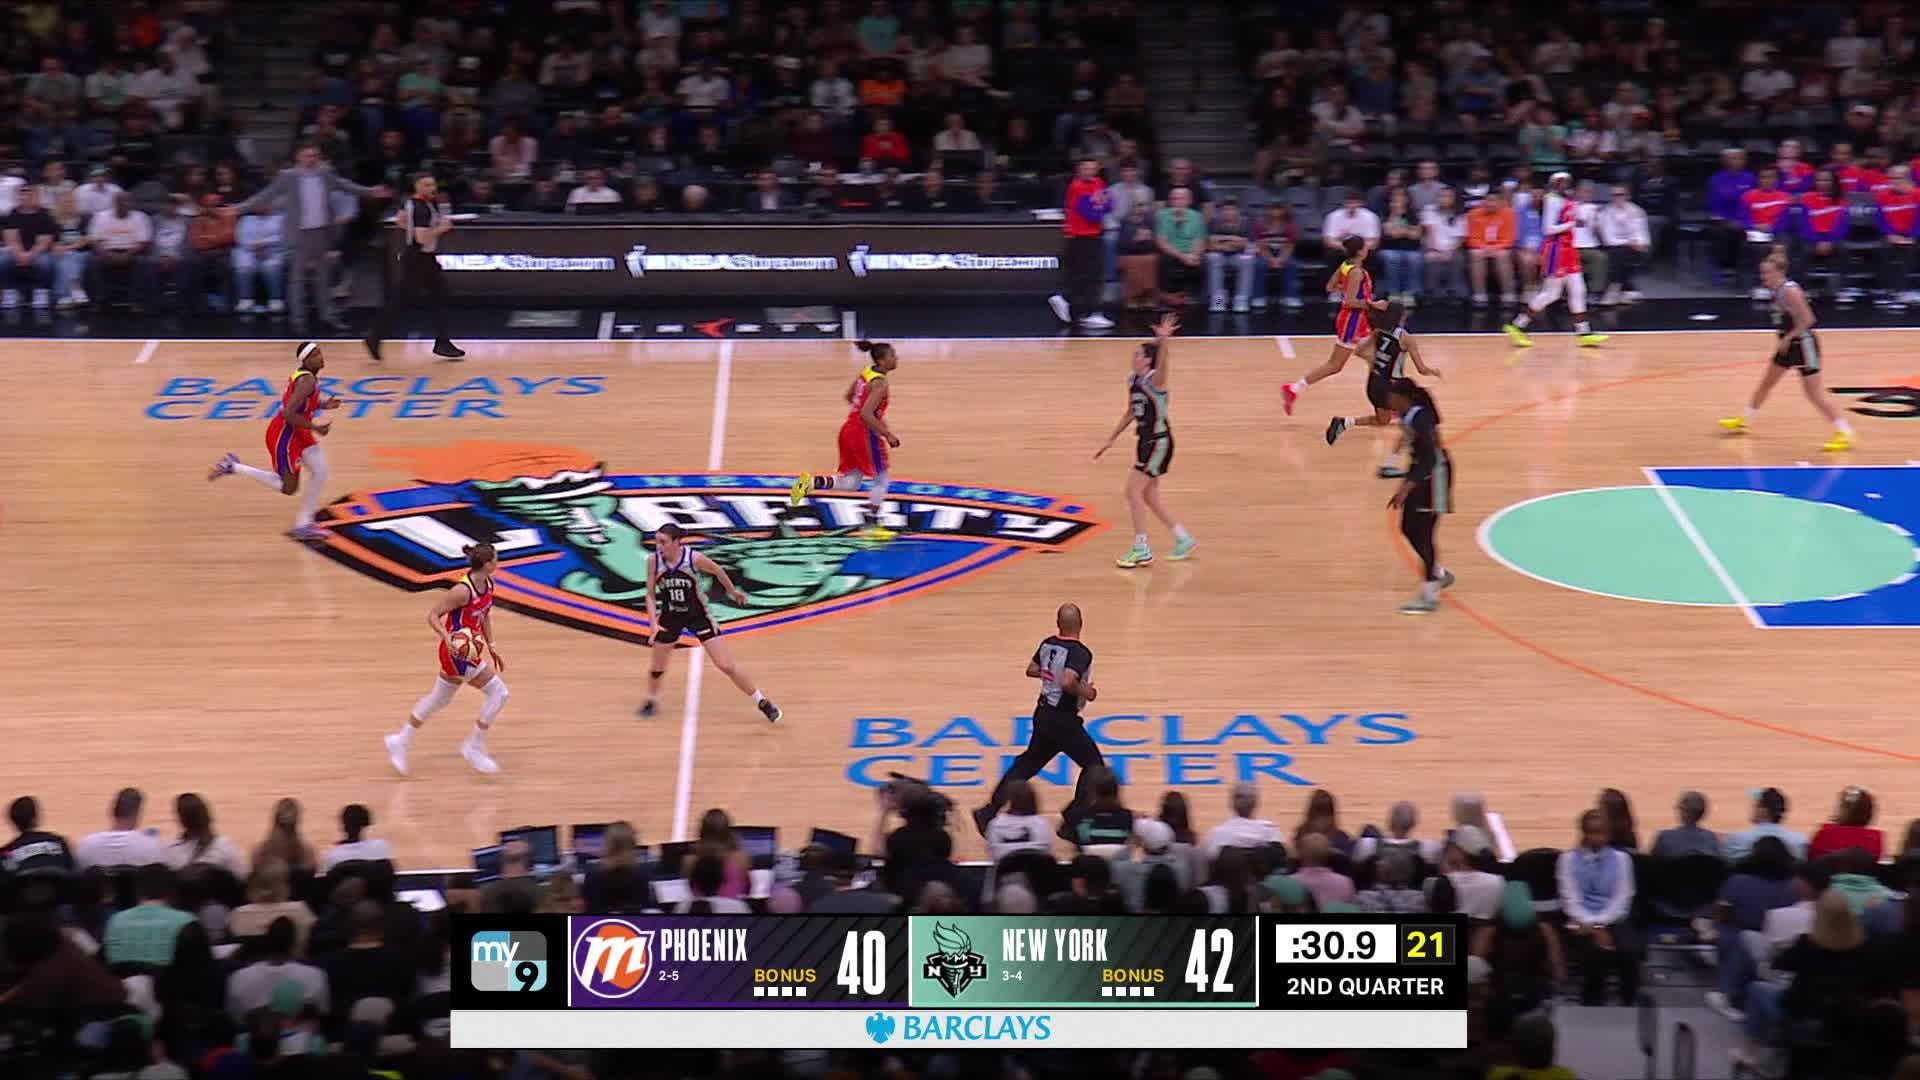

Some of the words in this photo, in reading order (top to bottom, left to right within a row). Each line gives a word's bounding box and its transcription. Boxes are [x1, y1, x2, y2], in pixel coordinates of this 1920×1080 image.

[157, 376, 606, 397] BARCLAYS
[641, 475, 796, 487] NEW
[669, 589, 685, 602] 18
